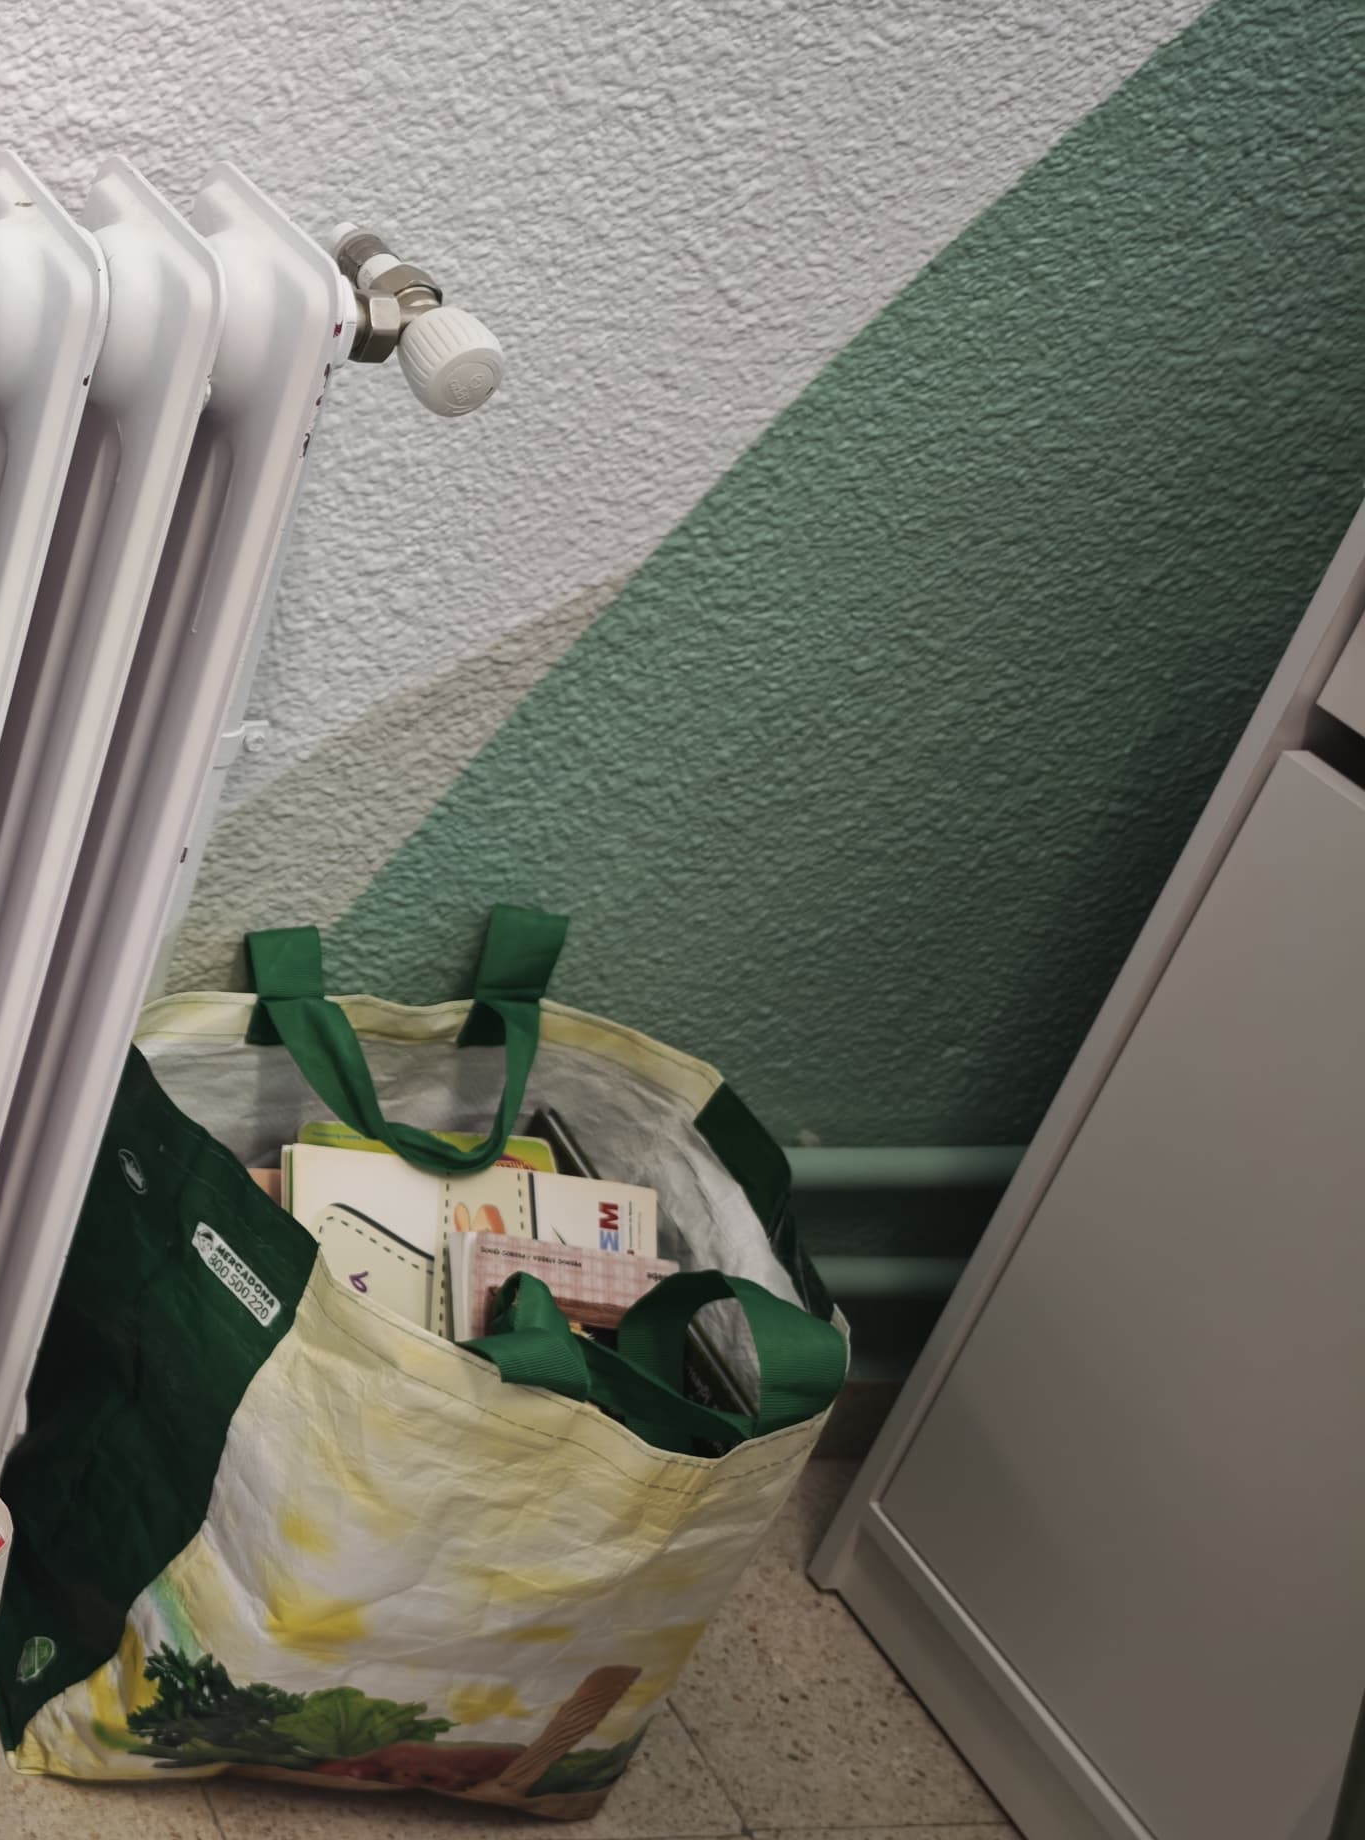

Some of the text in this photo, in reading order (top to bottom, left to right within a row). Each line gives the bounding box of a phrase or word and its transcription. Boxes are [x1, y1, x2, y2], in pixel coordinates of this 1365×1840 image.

[208, 1253, 270, 1320] 800 500 220
[215, 1245, 276, 1309] MERCADONA
